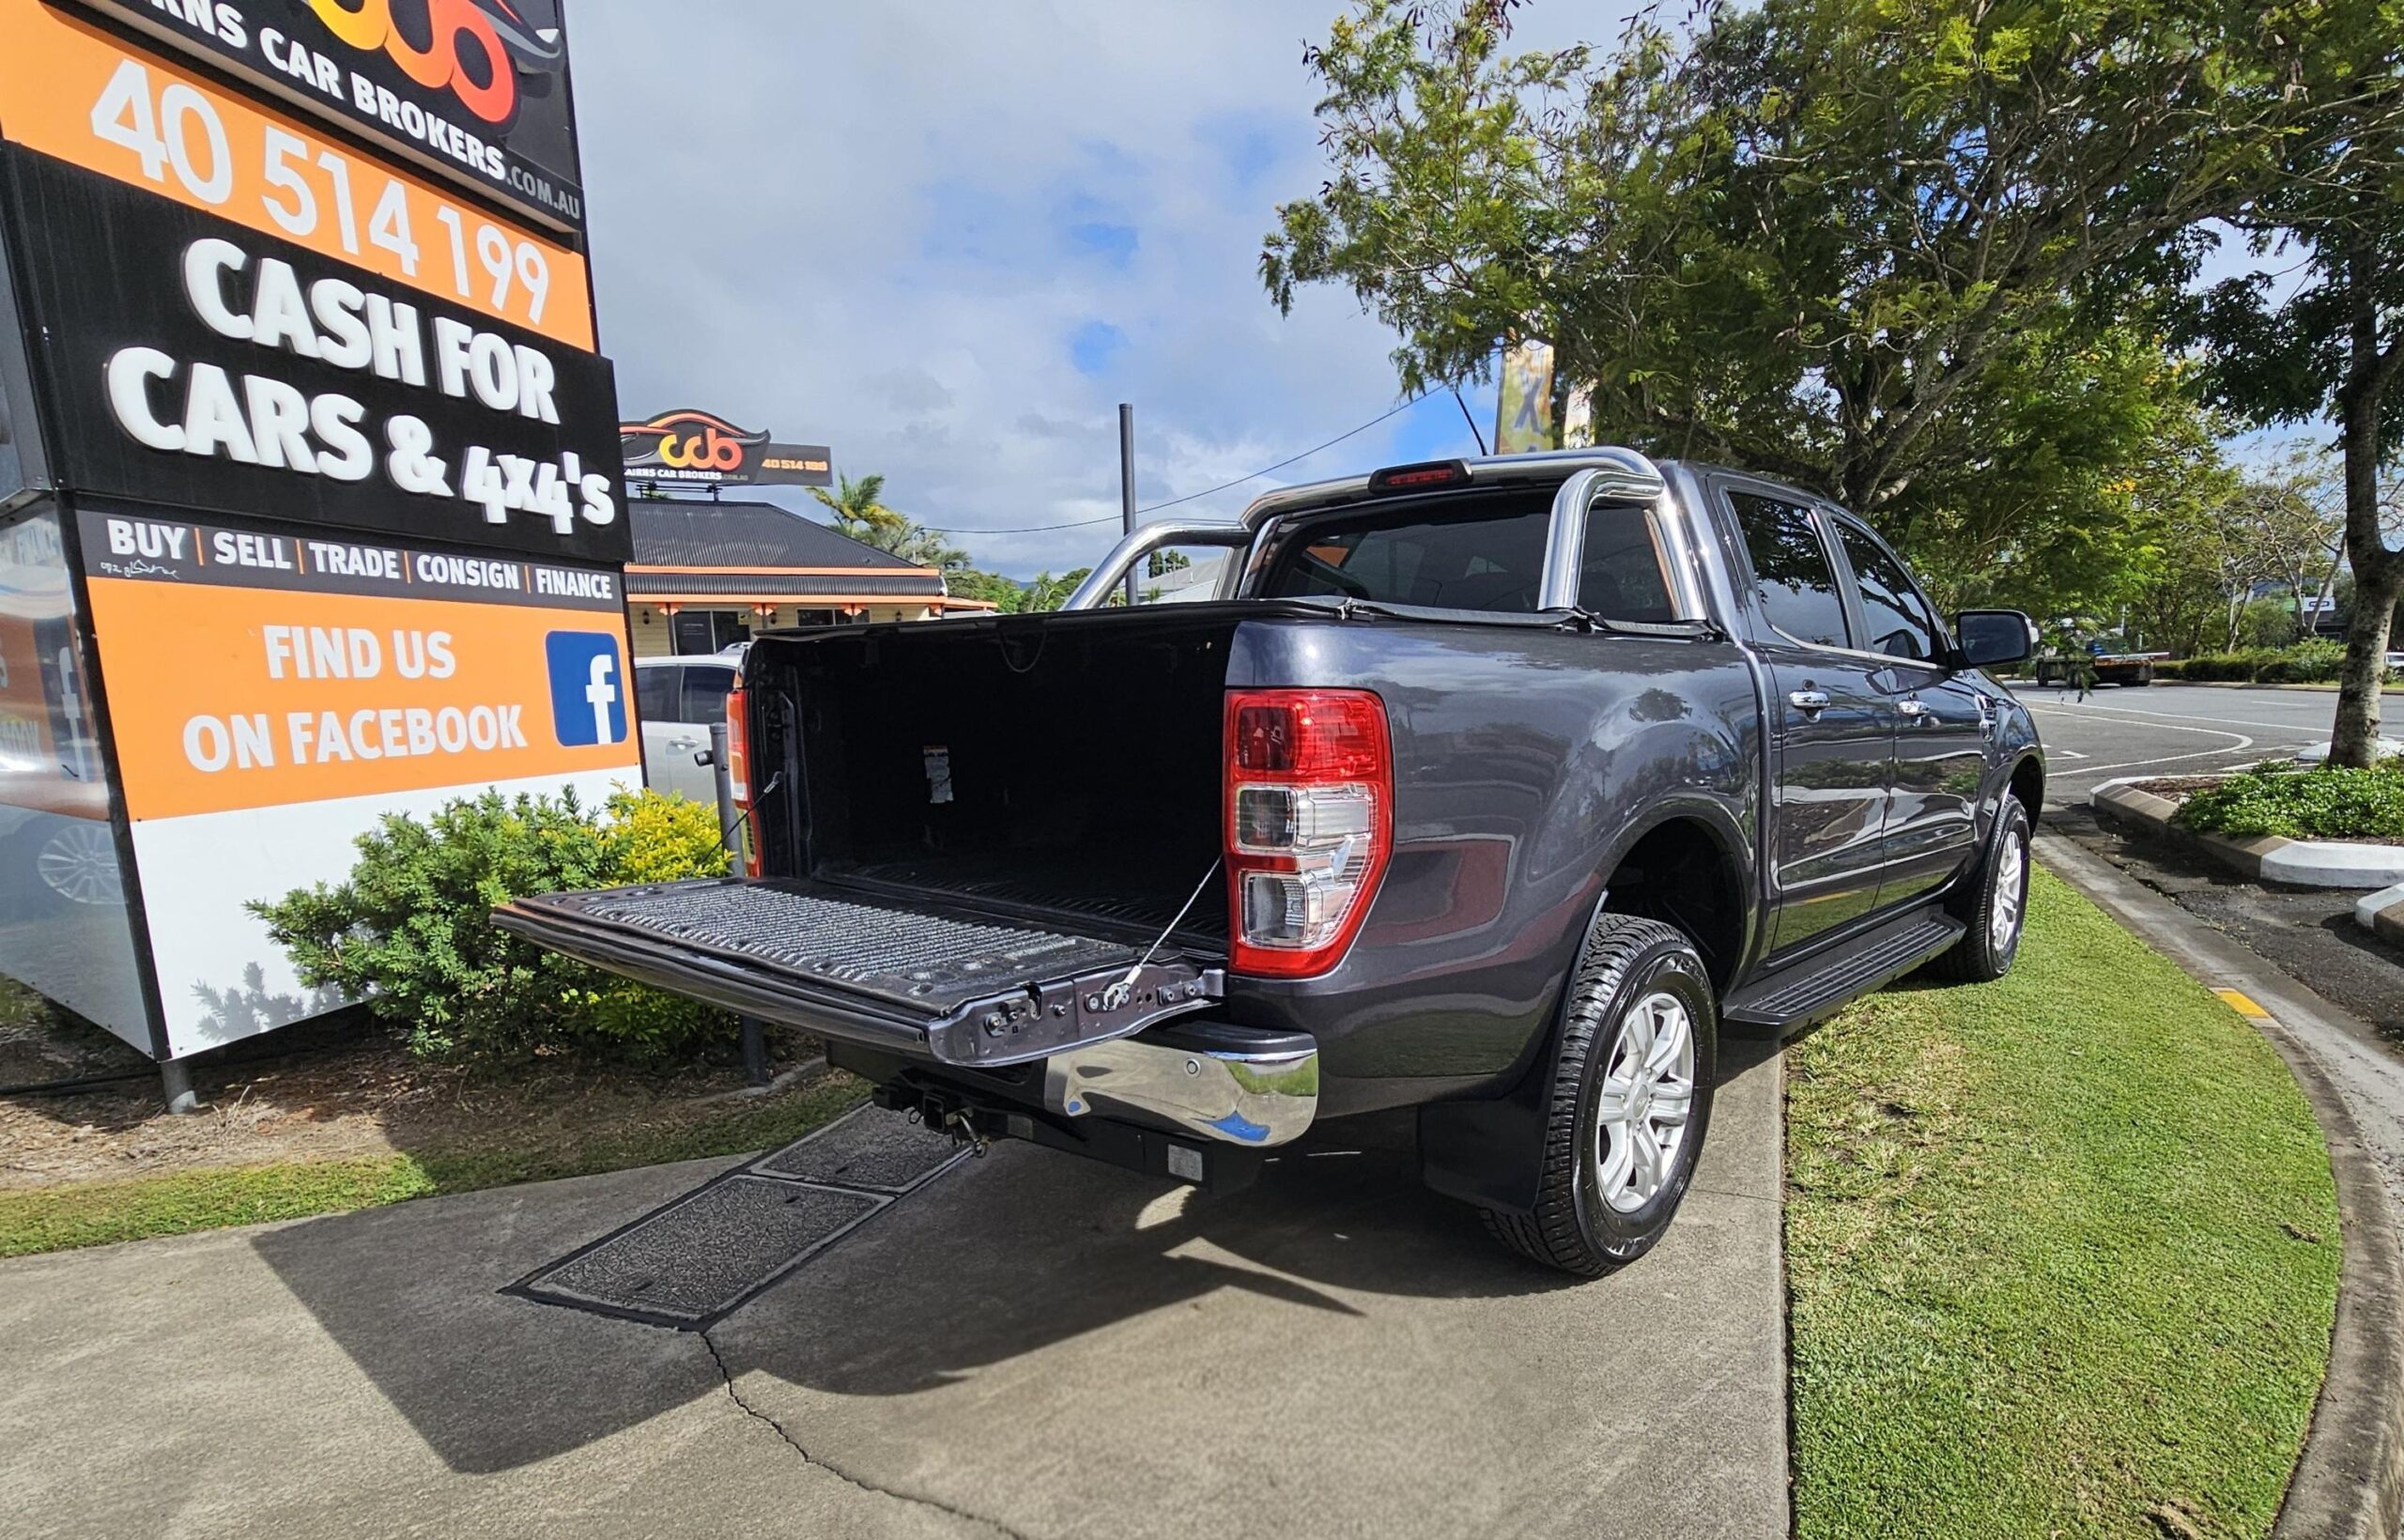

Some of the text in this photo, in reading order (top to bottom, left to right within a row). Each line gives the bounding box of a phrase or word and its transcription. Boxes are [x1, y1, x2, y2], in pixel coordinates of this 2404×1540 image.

[259, 27, 344, 100] CAR
[350, 71, 579, 220] BROKERS.COM.AU
[90, 58, 549, 326] 40 514 199
[184, 239, 558, 424] CASH FOR
[108, 346, 372, 481] CARS
[385, 415, 453, 497] &
[624, 469, 655, 477] AIRNS
[657, 470, 677, 478] CAR
[107, 519, 612, 599] BUY SELL TRADE CONSIGN FINANCE
[263, 625, 455, 680] FIND US
[183, 705, 528, 772] ON FACEBOOK
